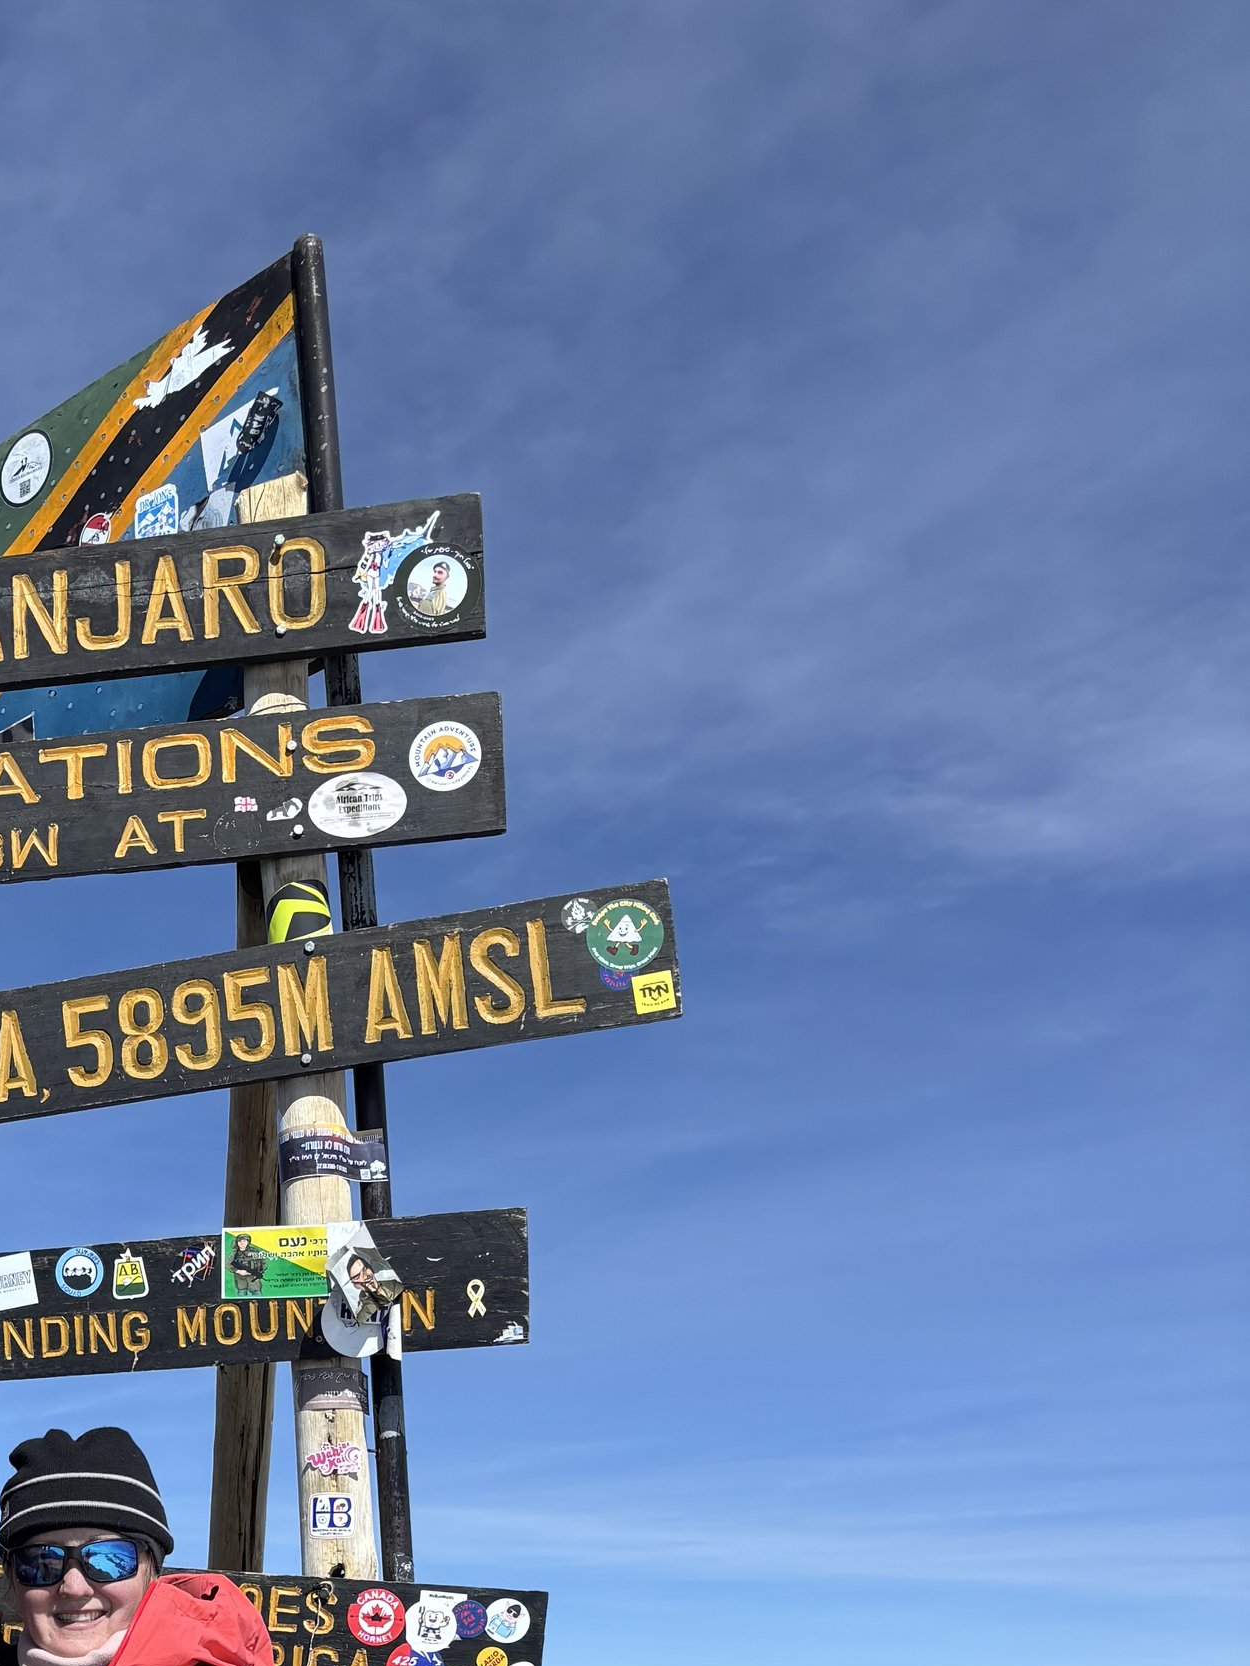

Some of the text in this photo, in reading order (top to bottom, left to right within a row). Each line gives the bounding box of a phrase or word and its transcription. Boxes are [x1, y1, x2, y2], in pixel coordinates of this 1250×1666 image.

[414, 724, 478, 768] MOUNTAIN ADVENTURE
[336, 792, 384, 804] African Trips
[338, 803, 381, 815] Expeditions
[115, 808, 207, 859] AT
[620, 900, 633, 908] City
[638, 982, 670, 999] TMN
[62, 955, 335, 1089] 5895M
[364, 917, 587, 1044] AMSL
[177, 1288, 436, 1348] MOUNN
[356, 1590, 399, 1610] CANADA
[357, 1630, 393, 1645] HORNET
[391, 1655, 419, 1666] 425
